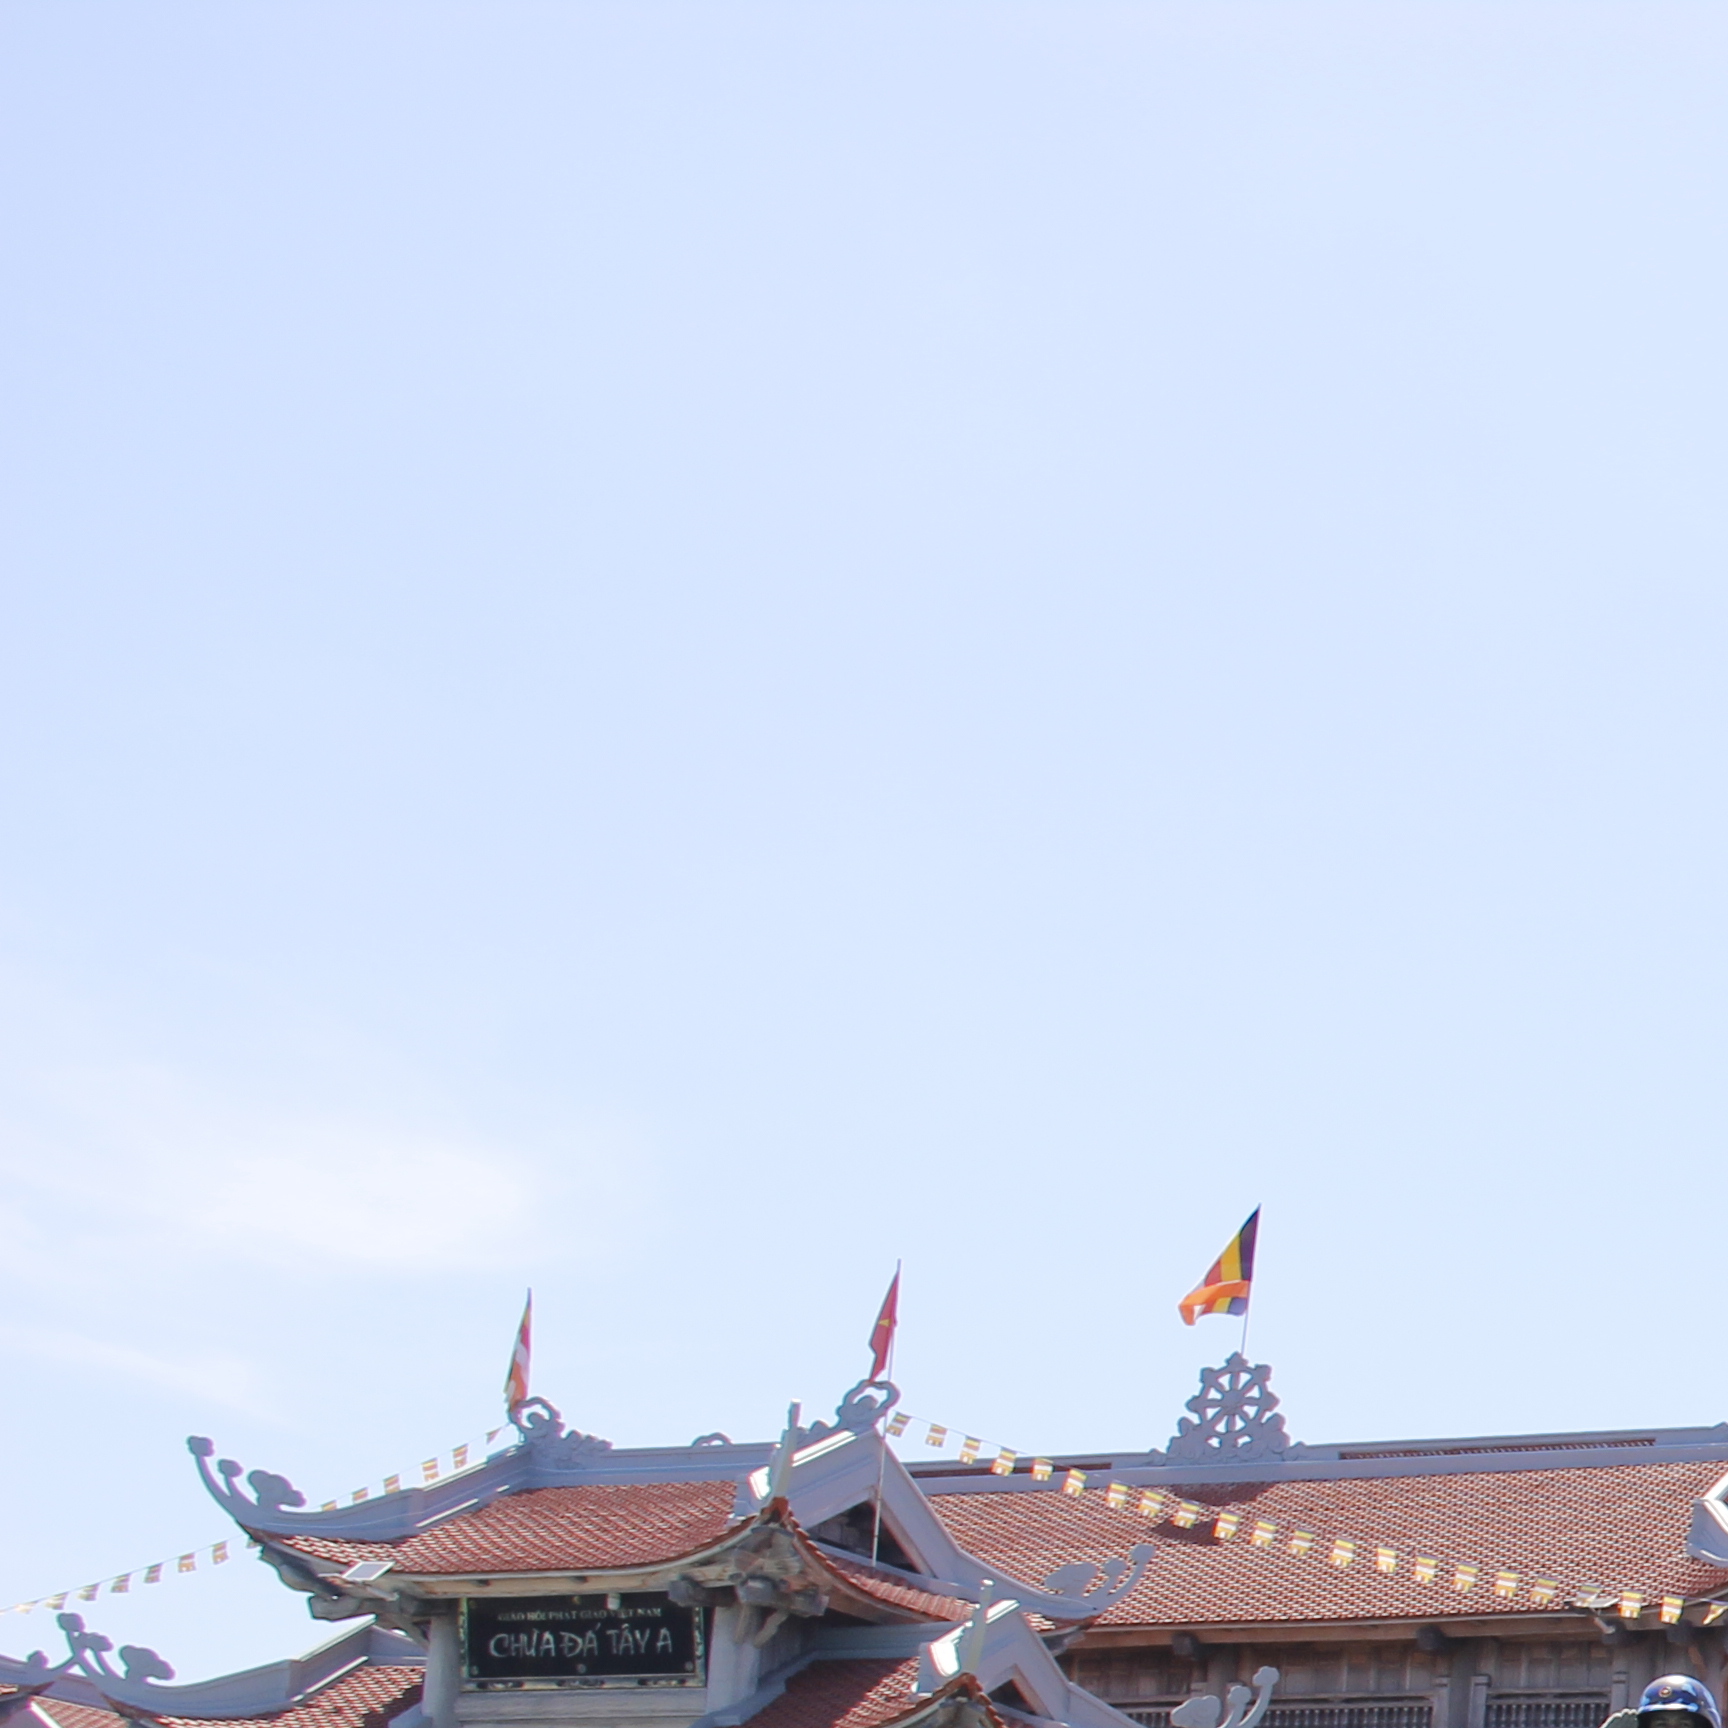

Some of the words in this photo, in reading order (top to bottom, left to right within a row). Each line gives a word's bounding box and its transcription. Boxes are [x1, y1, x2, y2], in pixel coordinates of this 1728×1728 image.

[559, 1622, 601, 1657] ĐÁ
[605, 1623, 650, 1655] TÂY
[656, 1627, 672, 1653] A
